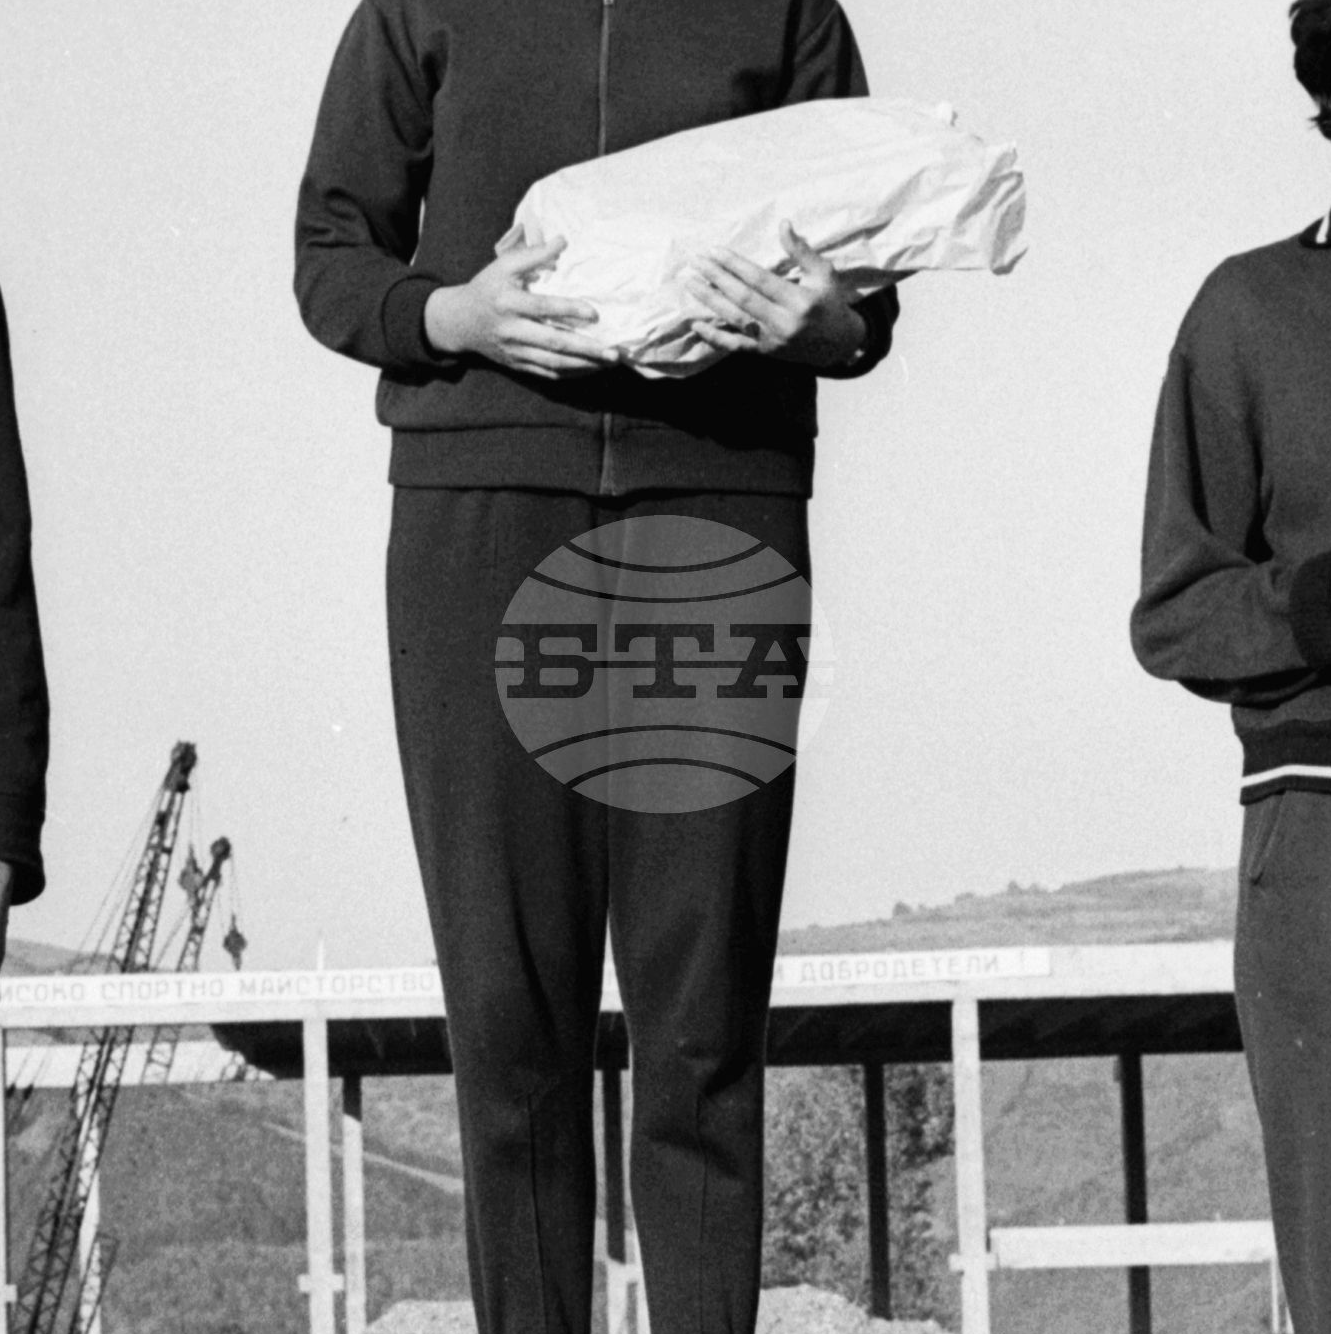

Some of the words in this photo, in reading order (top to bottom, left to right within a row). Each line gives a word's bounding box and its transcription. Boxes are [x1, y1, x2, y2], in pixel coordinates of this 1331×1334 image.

[1, 982, 85, 1002] ИСОКО
[100, 978, 224, 1000] СПОРТНО
[799, 954, 999, 984] ДОБРОДЕТЕЛИ
